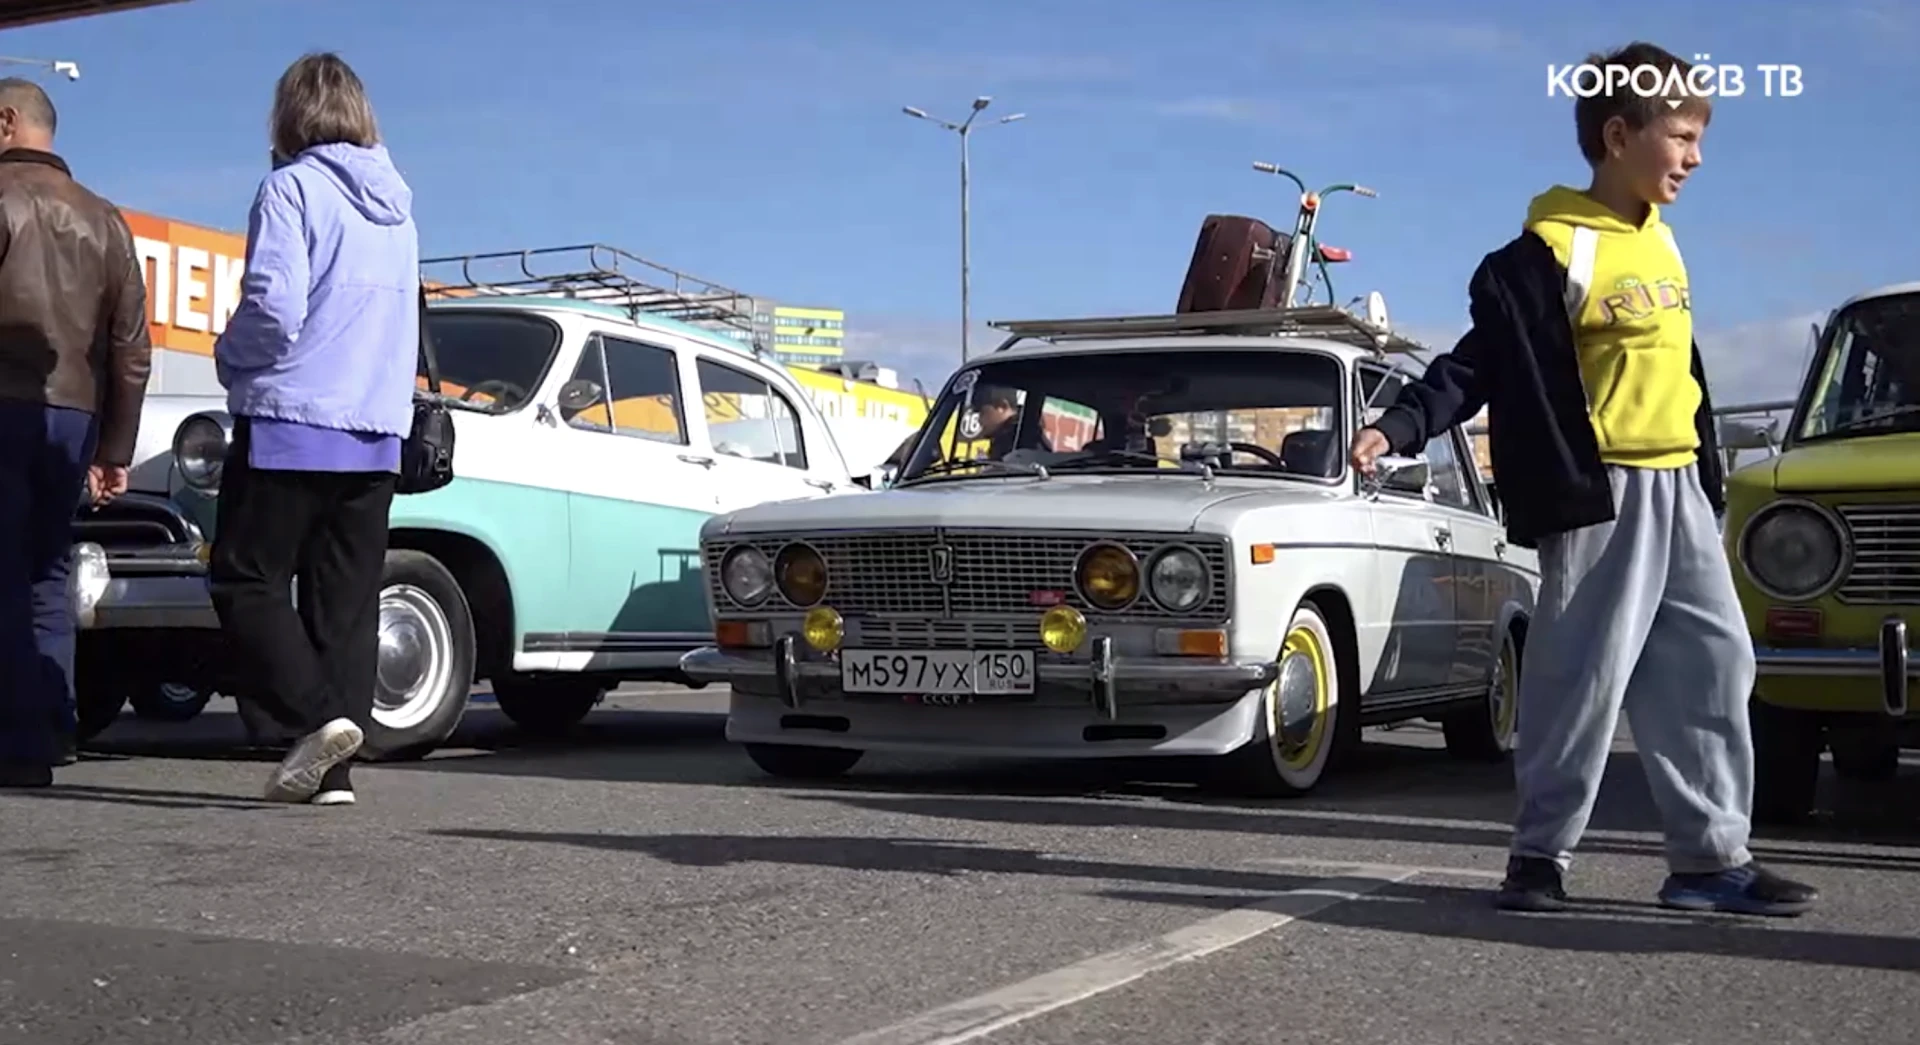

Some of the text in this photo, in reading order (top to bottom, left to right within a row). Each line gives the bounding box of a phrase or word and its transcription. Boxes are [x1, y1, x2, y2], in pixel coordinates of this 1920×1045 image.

[852, 653, 1026, 689] М597УХ 150
[990, 679, 1013, 690] RUS
